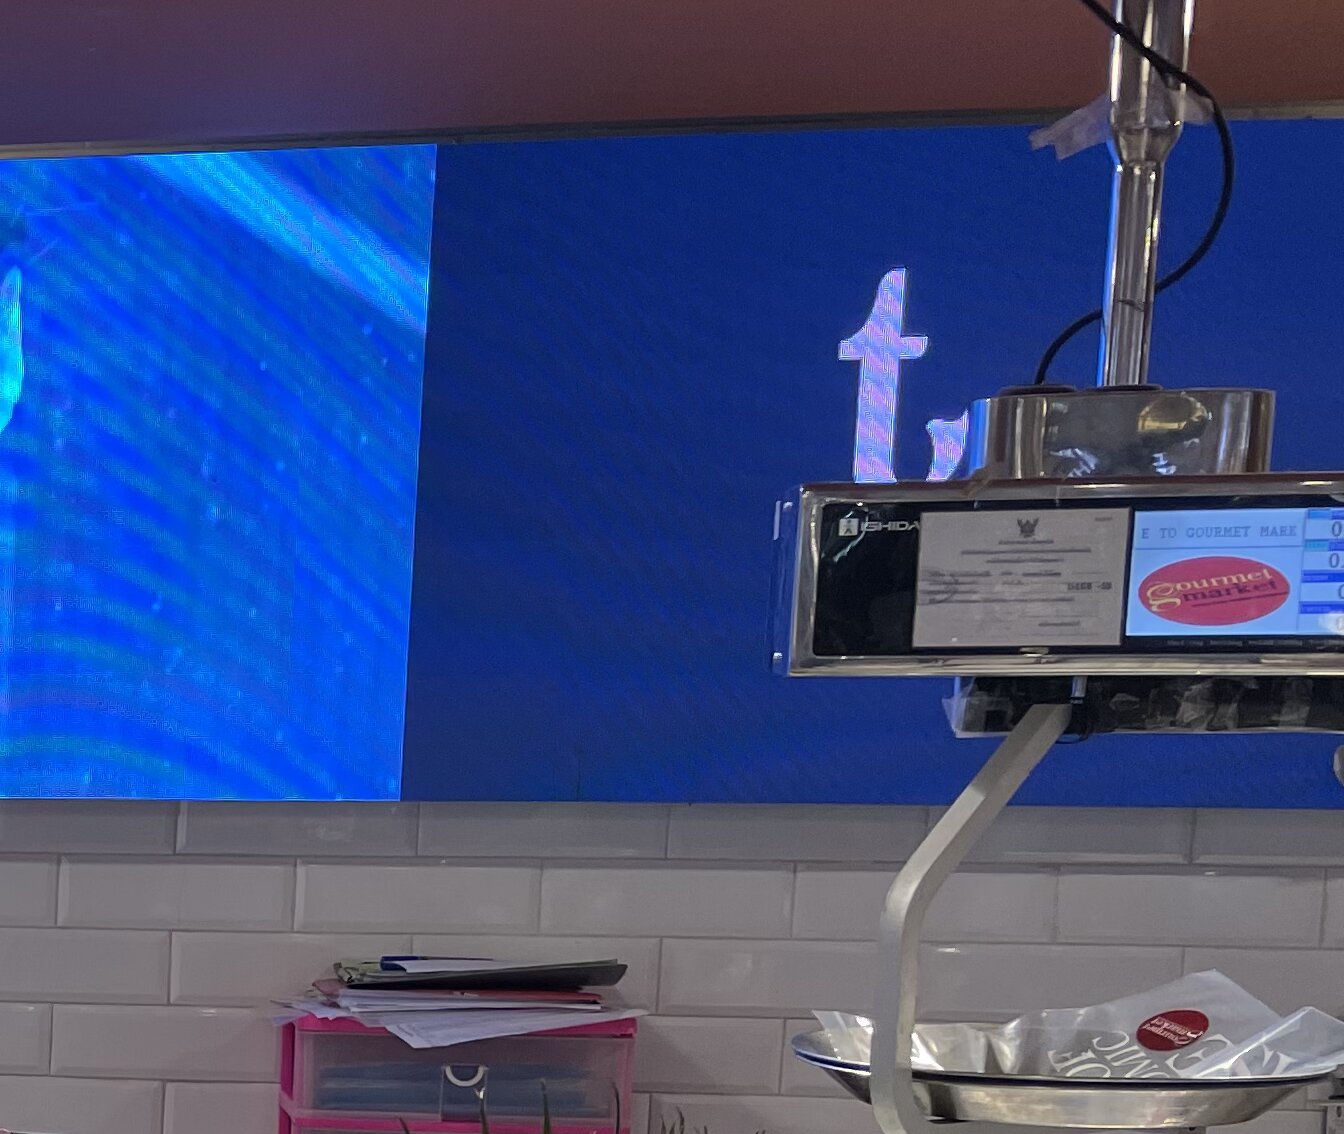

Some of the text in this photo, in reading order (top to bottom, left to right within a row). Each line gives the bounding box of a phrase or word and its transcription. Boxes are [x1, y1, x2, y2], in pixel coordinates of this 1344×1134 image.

[1160, 527, 1177, 539] TO
[1186, 526, 1251, 538] GOURMET
[1147, 568, 1272, 611] Gourmet
[1182, 580, 1278, 602] market
